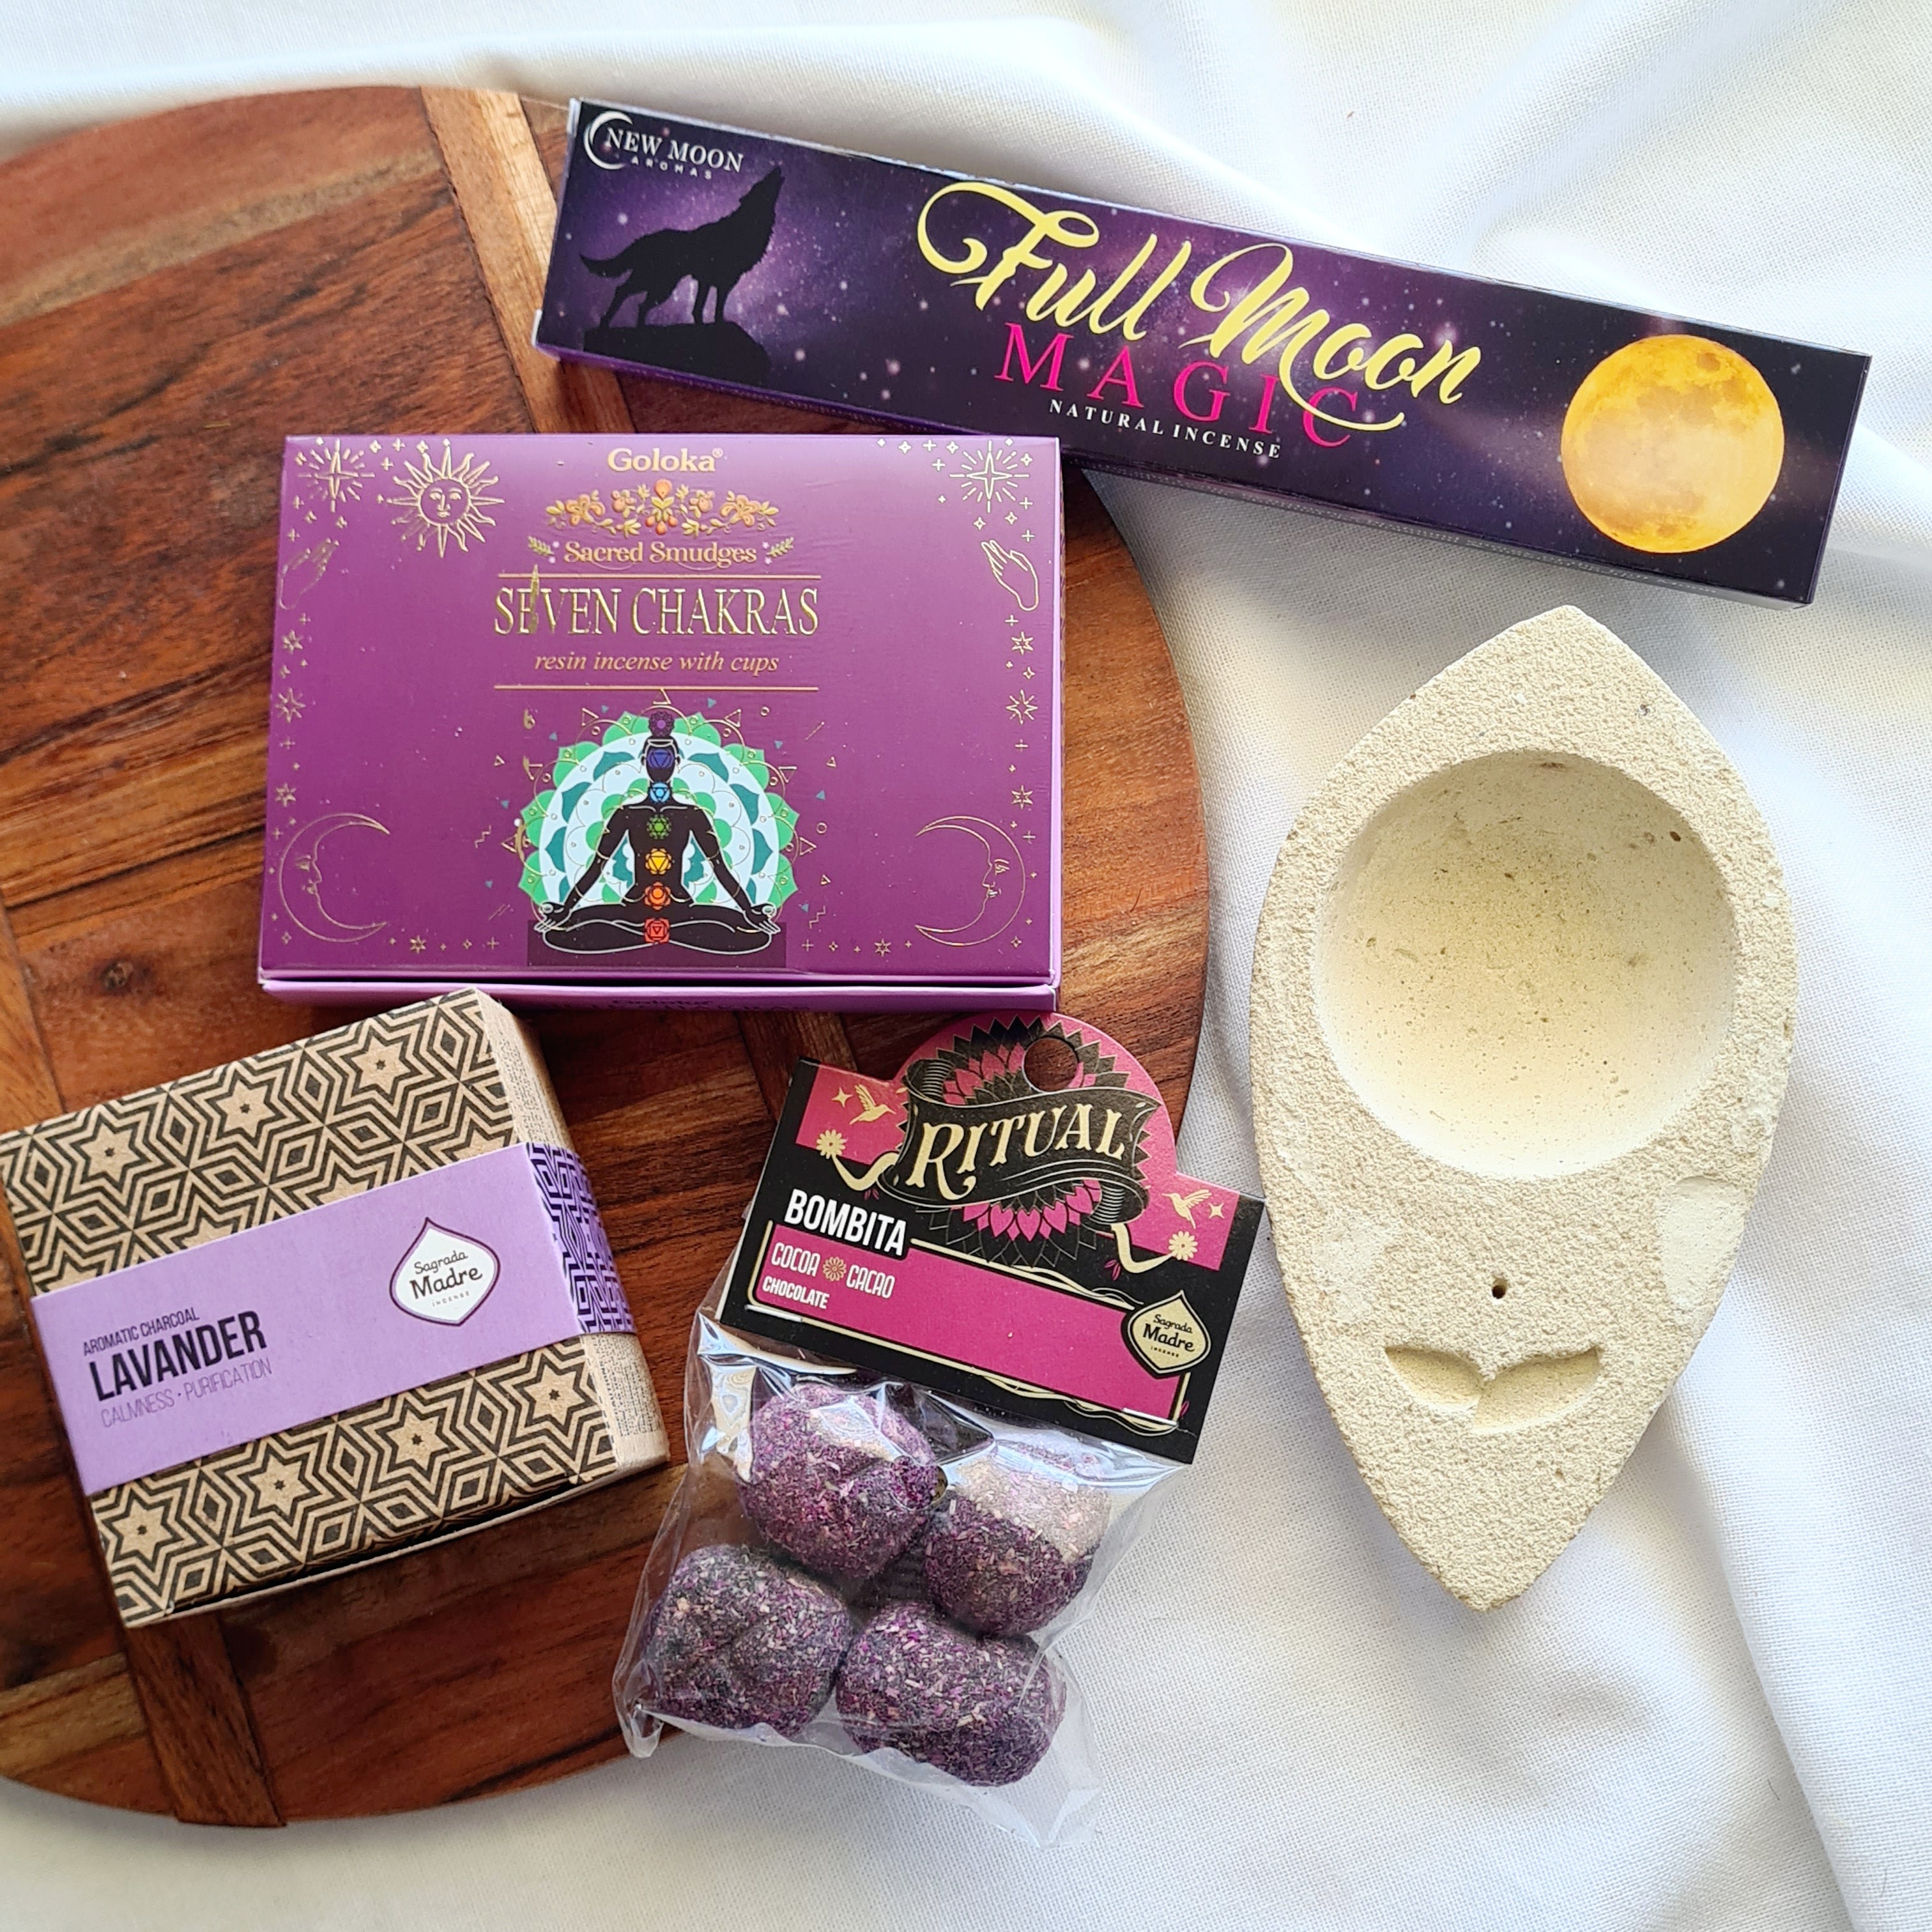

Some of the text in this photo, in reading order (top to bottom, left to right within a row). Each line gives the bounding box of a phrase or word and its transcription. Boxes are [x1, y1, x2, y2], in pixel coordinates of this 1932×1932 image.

[604, 128, 744, 173] NEW MOON
[631, 156, 712, 180] AROMAS
[917, 182, 1482, 431] Full Moon
[994, 321, 1361, 449] MAGIC
[1048, 399, 1282, 459] NATURAL INCENSE
[563, 541, 758, 567] Sacred Smudges
[494, 587, 819, 635] SEVEN CHAKRAS
[534, 652, 779, 677] resin incense with cups
[905, 1103, 1126, 1200] RITUAL
[784, 1188, 907, 1257] BOMBITA
[409, 1267, 483, 1300] Madre
[413, 1250, 468, 1275] Sagrada
[770, 1241, 896, 1300] COCOA CACAO
[762, 1275, 830, 1311] CHOCOLATE
[82, 1307, 200, 1356] AROMATIC CHARCOAL
[1142, 1322, 1195, 1353] Madre
[1153, 1314, 1193, 1334] Sagrada
[89, 1310, 268, 1402] LAVANDER
[100, 1356, 273, 1428] CALMNESS PURIFICATION
